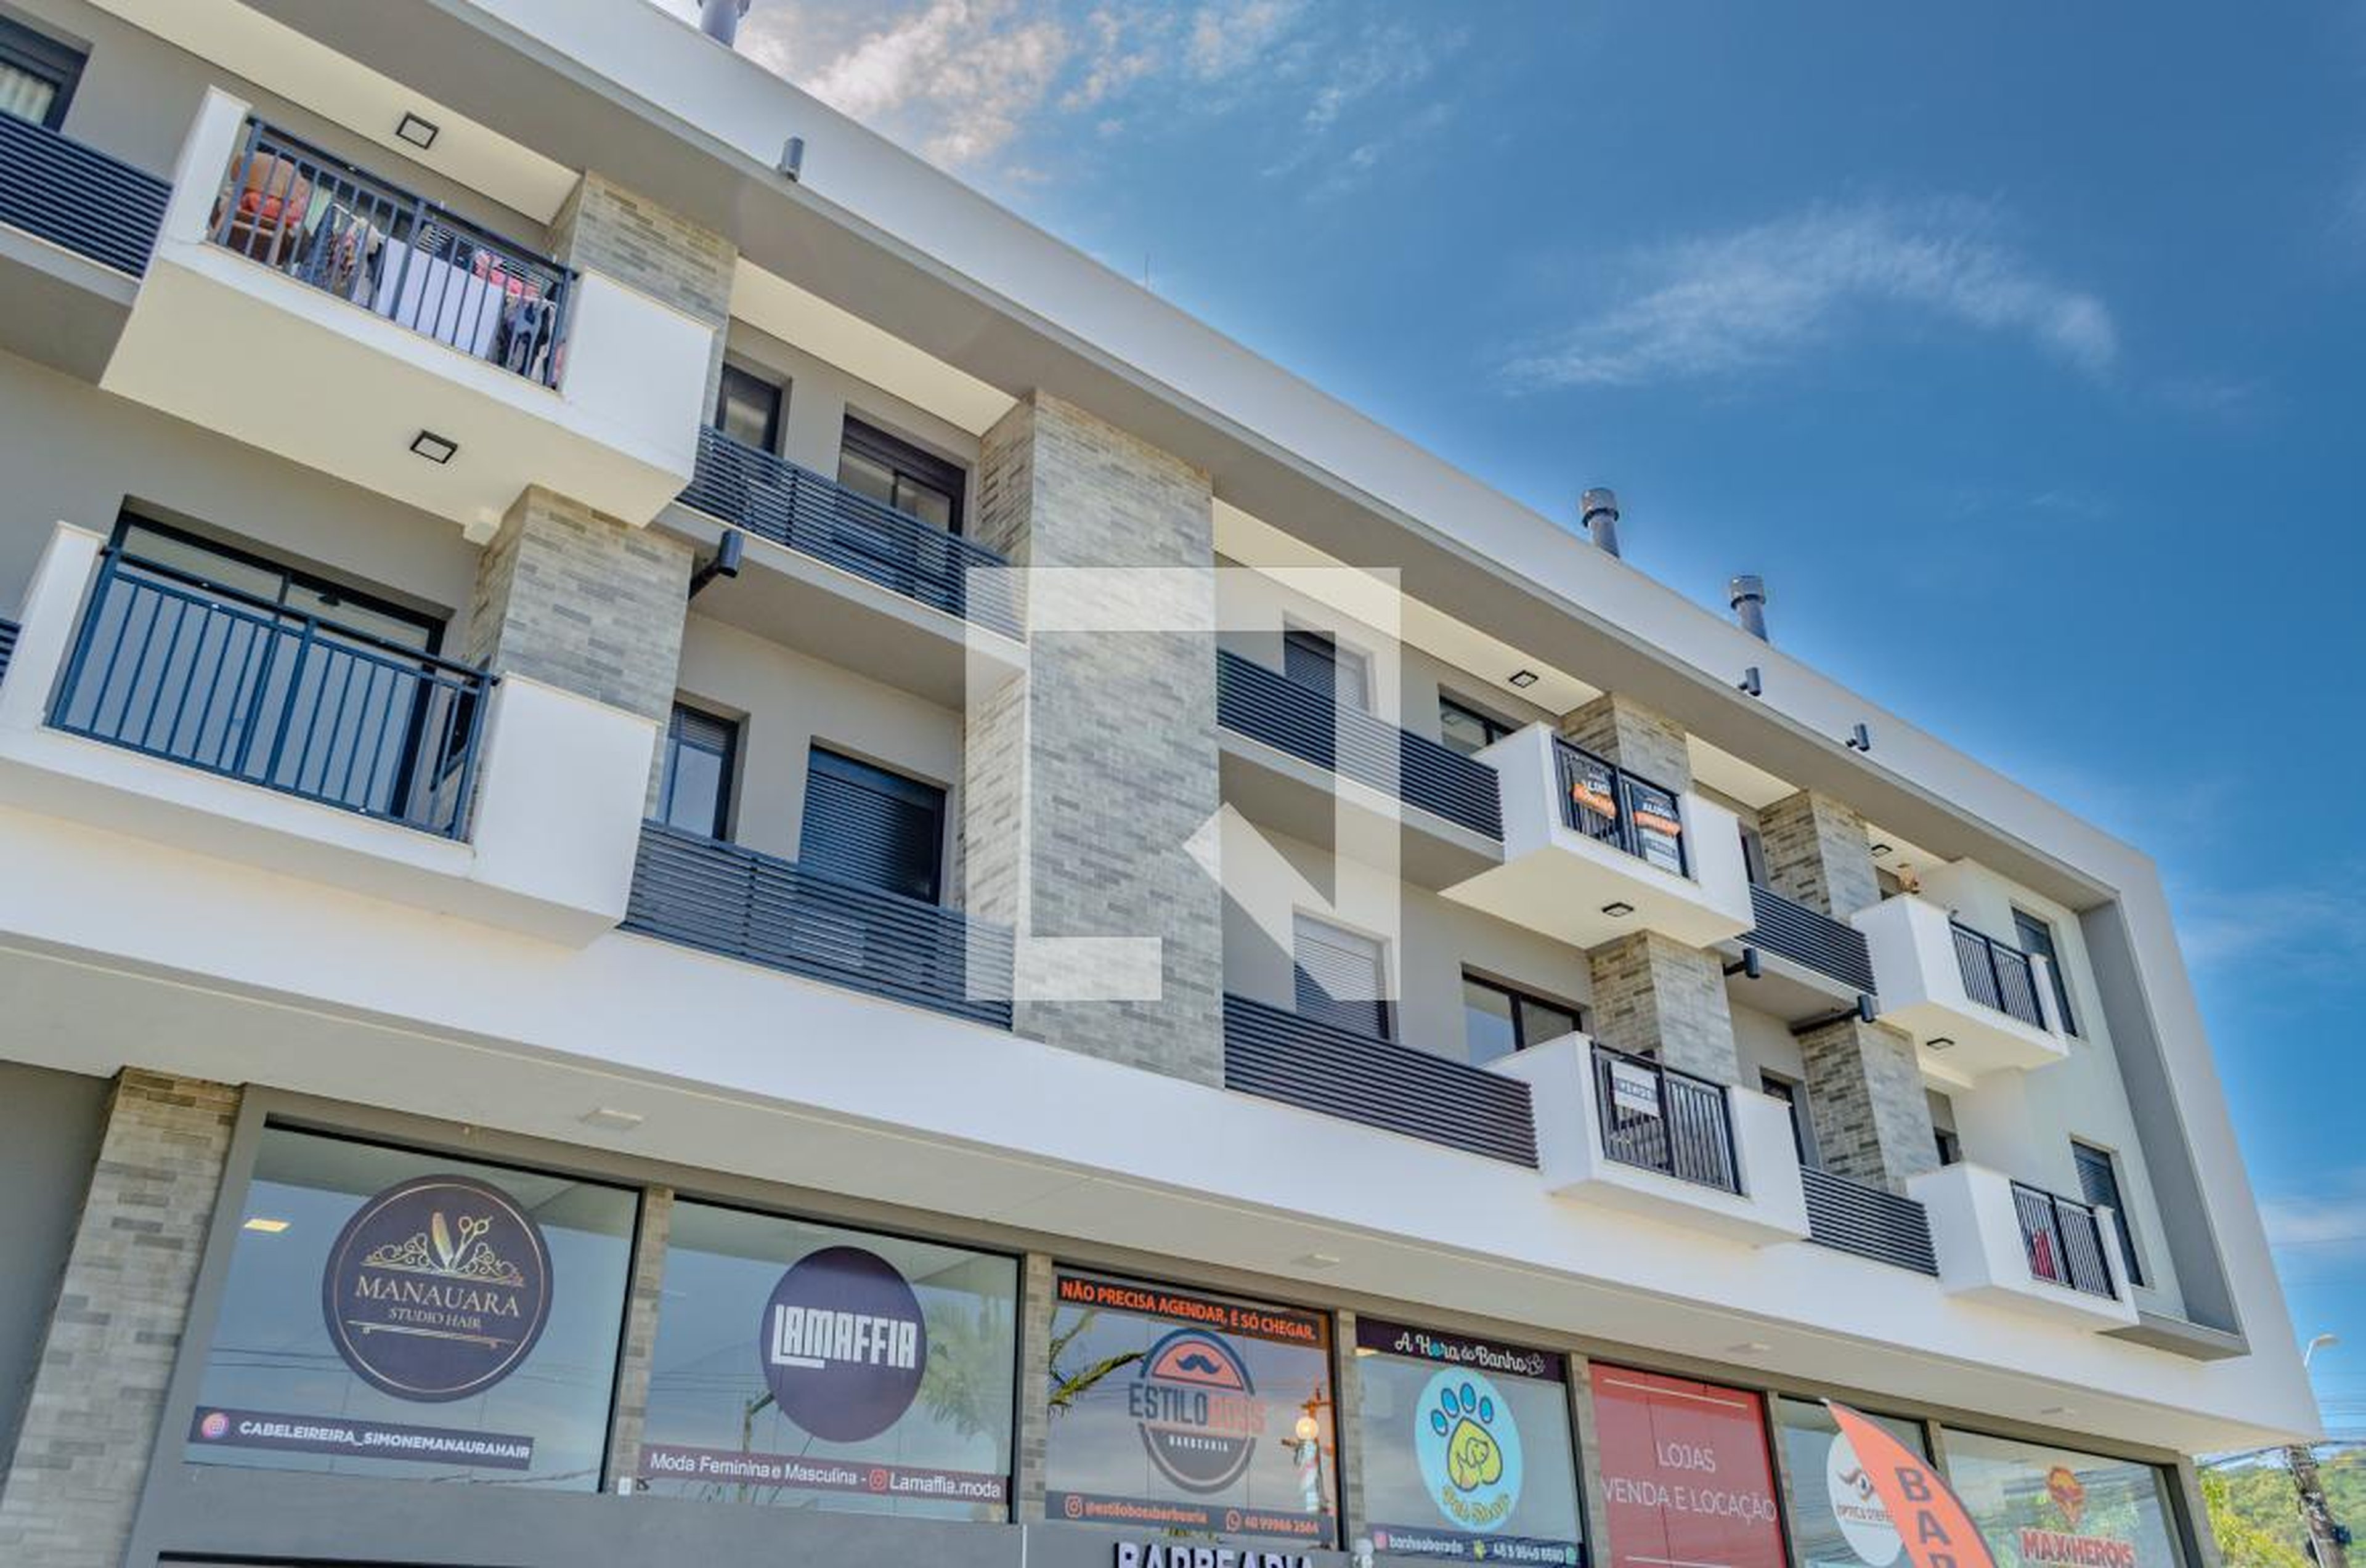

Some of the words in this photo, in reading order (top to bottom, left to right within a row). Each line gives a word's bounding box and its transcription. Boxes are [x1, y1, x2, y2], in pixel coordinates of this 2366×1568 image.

[356, 1275, 519, 1317] MANAUARA
[389, 1308, 444, 1323] STUDIO
[445, 1313, 481, 1328] HAIR
[1060, 1280, 1095, 1301] NÃO
[1097, 1287, 1157, 1312] PRECISA
[1230, 1307, 1239, 1326] É
[1240, 1312, 1259, 1330] SÓ
[1261, 1317, 1317, 1340] CHEGAR.
[771, 1304, 917, 1369] LAMAFFIA
[1394, 1331, 1413, 1352] A
[1416, 1334, 1460, 1362] Hora
[1476, 1345, 1527, 1373] Banho
[650, 1452, 696, 1472] Moda
[699, 1455, 770, 1477] Feminina
[771, 1466, 781, 1479] e
[889, 1472, 1001, 1498] Lamaffia.moda
[1656, 1440, 1716, 1473] LOJAS
[1602, 1477, 1670, 1508] VENDA
[1673, 1485, 1689, 1510] E
[1691, 1489, 1778, 1527] LOCAÇÃO
